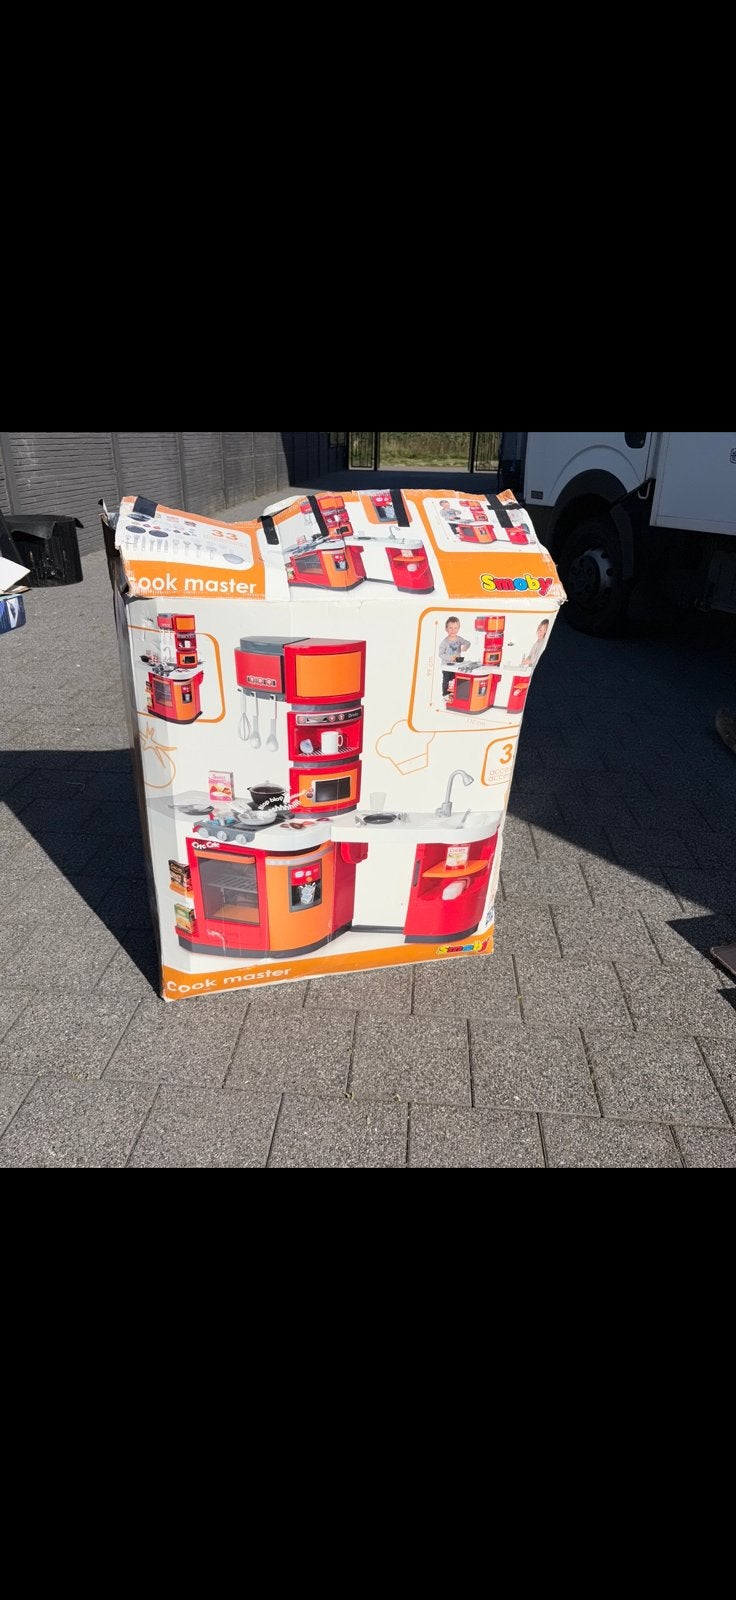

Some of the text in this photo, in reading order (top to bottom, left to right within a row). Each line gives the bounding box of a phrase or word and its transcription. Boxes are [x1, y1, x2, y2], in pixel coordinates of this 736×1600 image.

[211, 529, 238, 541] 33
[184, 578, 257, 594] master
[480, 573, 553, 597] Smoby
[437, 938, 490, 955] Smoby
[167, 968, 292, 994] Cook master
